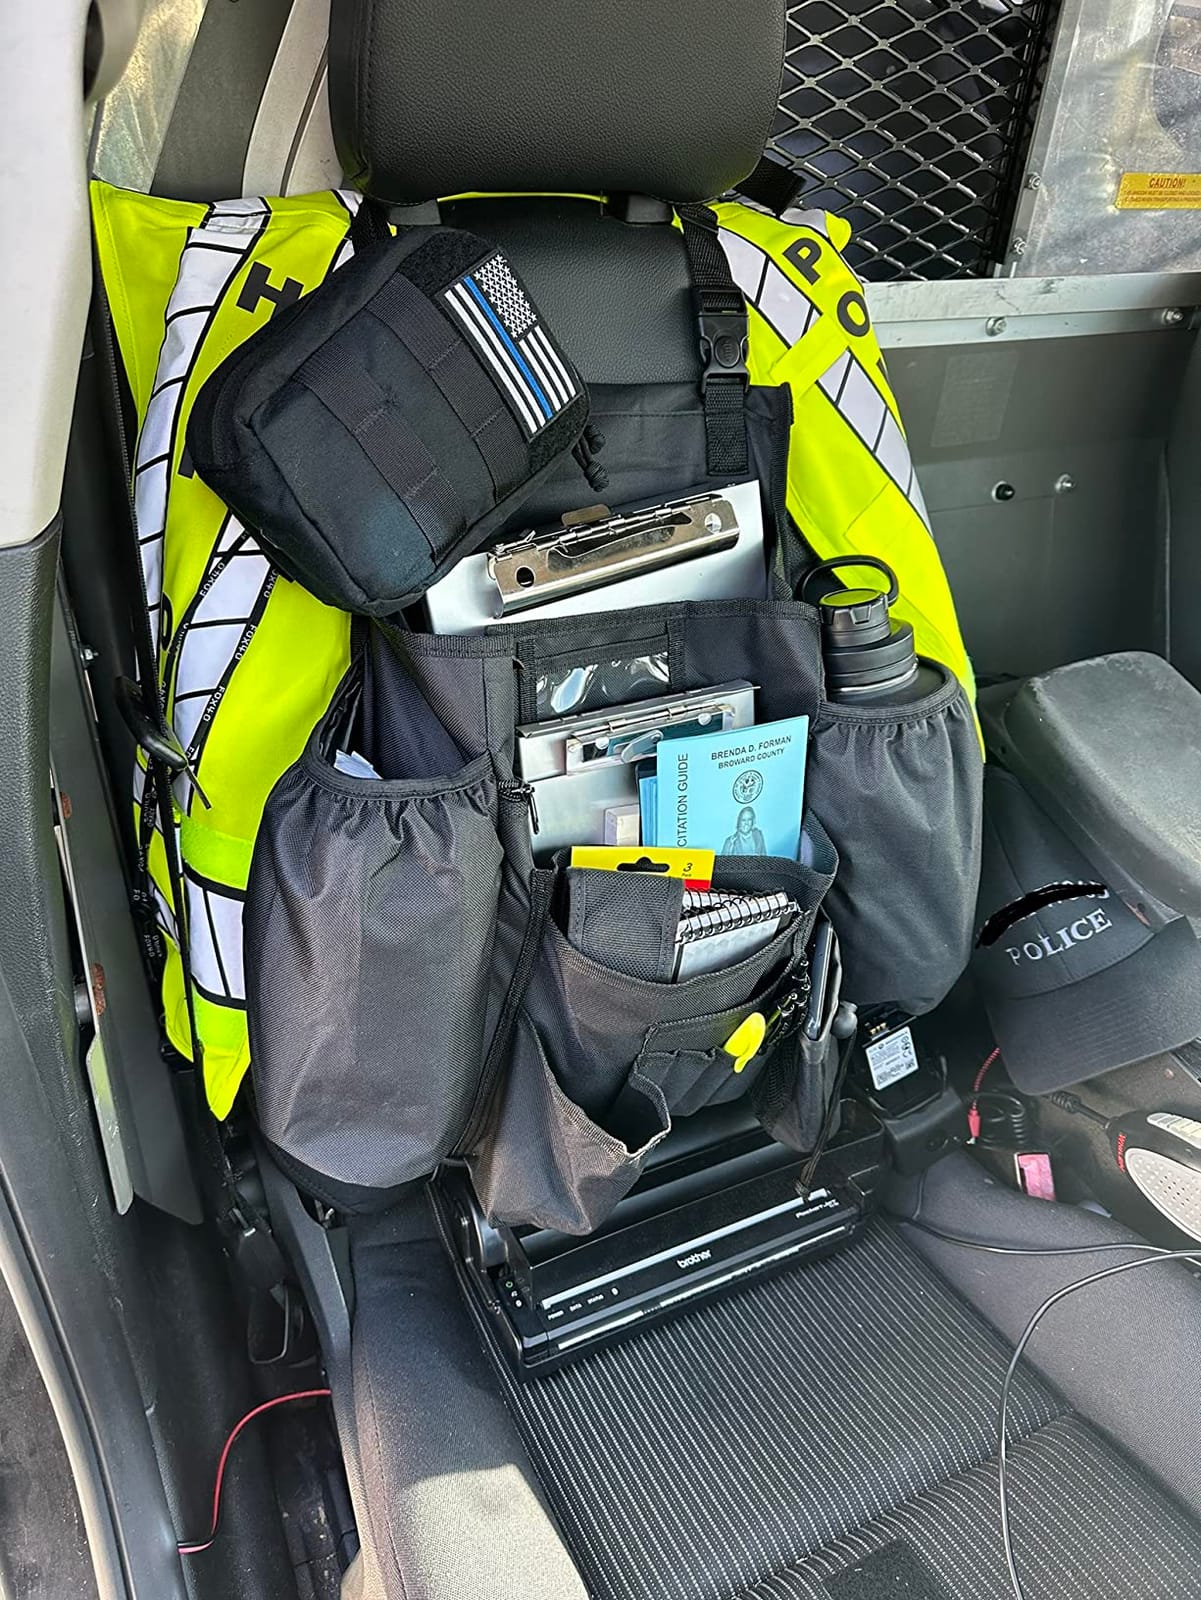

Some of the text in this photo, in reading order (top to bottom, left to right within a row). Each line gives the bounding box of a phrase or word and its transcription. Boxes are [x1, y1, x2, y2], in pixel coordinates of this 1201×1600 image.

[1149, 177, 1186, 189] CAUTION!
[234, 624, 257, 661] FOX40
[203, 685, 226, 722] FOX40
[711, 735, 792, 761] BRENDA D. FORMAN
[718, 748, 785, 769] BROWARD COUNTY
[677, 753, 688, 847] CITATION GUIDE
[683, 862, 693, 872] 3
[1005, 908, 1113, 966] POLICE
[676, 1249, 712, 1269] brother
